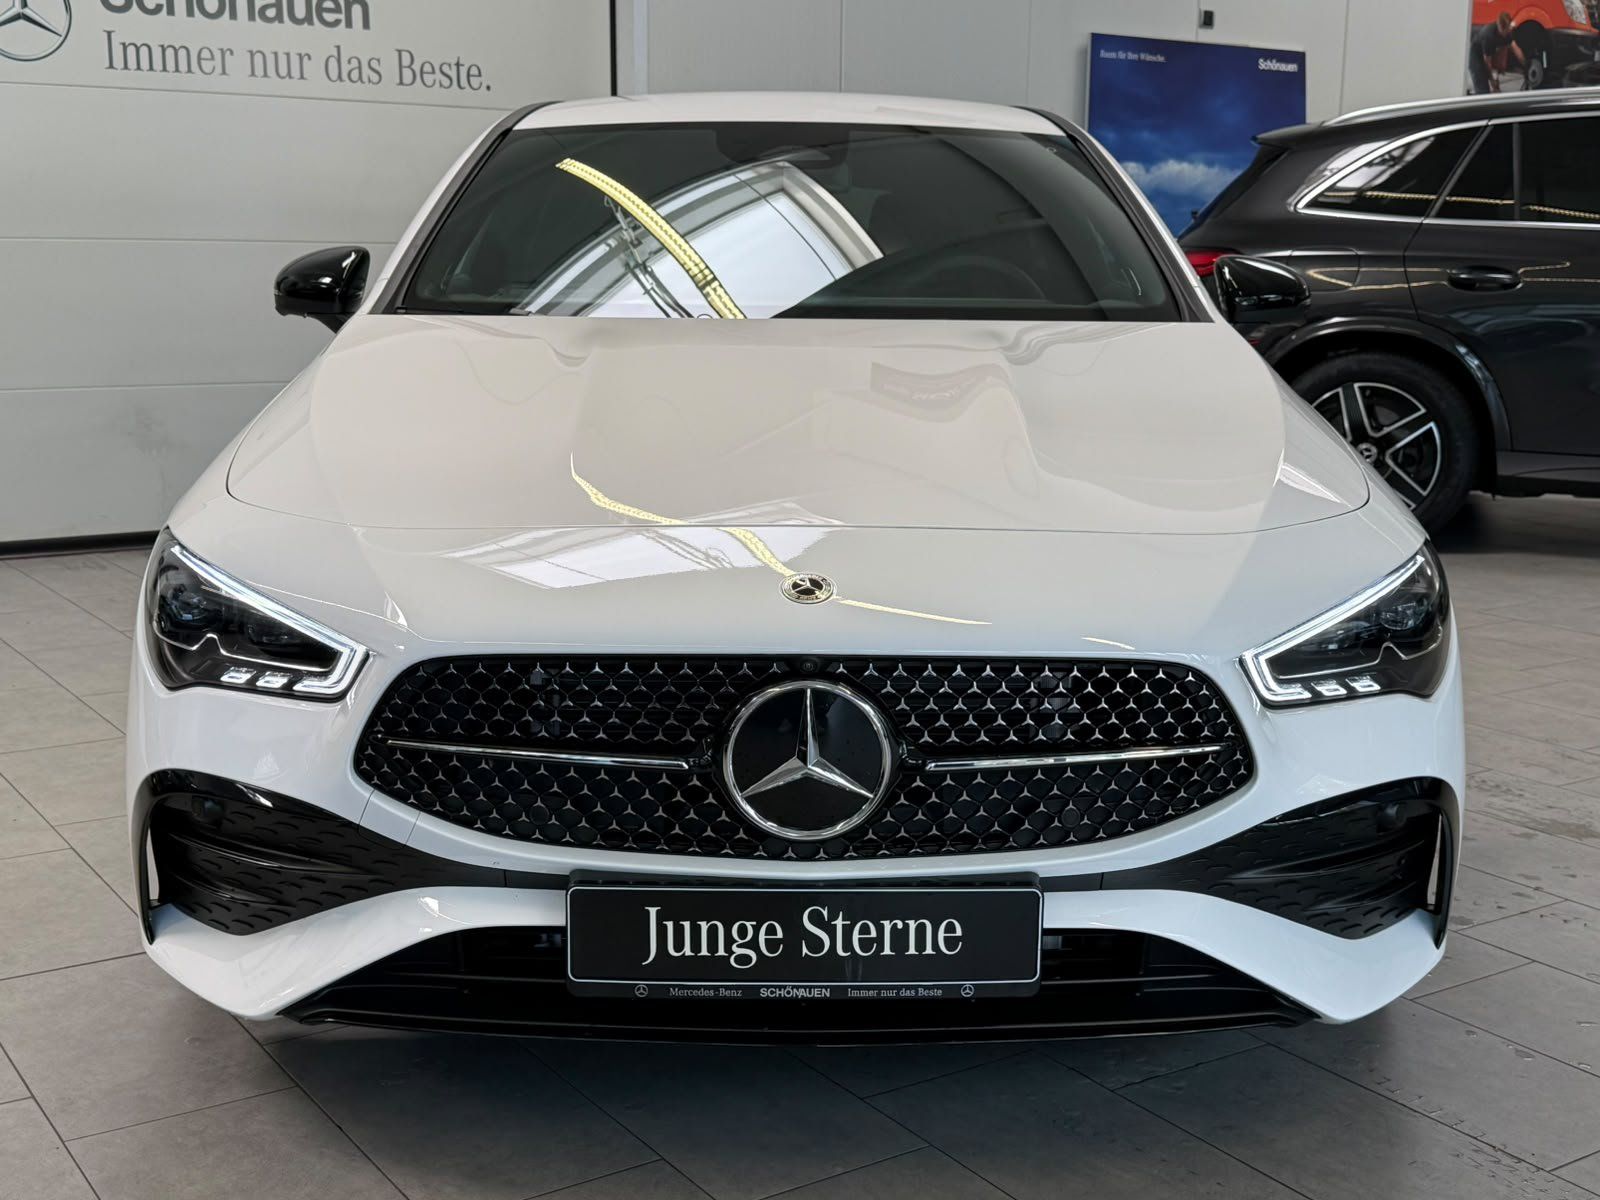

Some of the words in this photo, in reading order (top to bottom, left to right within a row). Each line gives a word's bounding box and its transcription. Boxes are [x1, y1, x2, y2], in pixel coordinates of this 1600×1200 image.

[103, 29, 234, 76] Immer
[248, 49, 312, 81] nur
[324, 44, 382, 85] das
[395, 48, 491, 91] Beste.
[1258, 58, 1298, 72] Schönauen
[641, 905, 785, 969] Junge
[801, 905, 964, 958] Sterne
[669, 987, 743, 998] Mercedes-Benz
[759, 985, 831, 998] SCHÖNAUEN
[847, 987, 879, 998] Immer
[880, 989, 898, 998] nur
[899, 987, 916, 998] das
[917, 987, 943, 997] Beste
